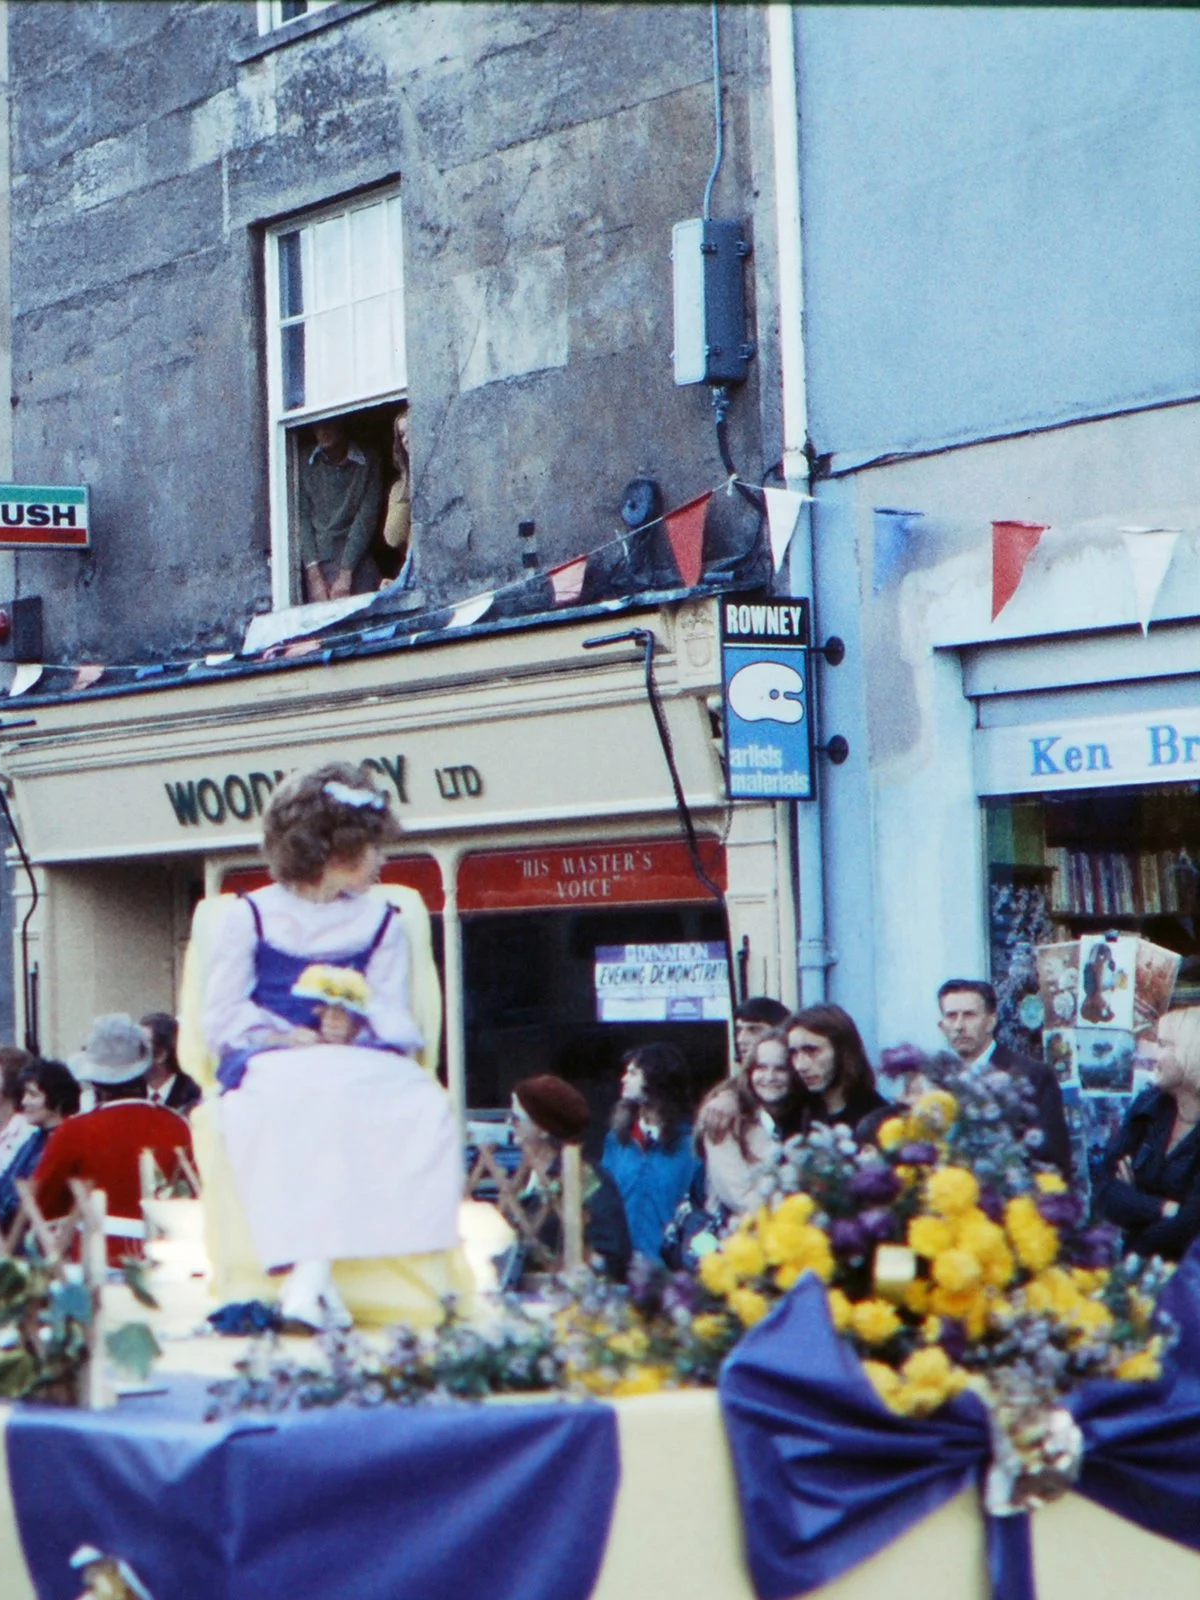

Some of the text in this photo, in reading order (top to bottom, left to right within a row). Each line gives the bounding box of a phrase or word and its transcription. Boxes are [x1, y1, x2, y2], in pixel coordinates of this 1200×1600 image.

[726, 604, 802, 636] ROWNEY
[730, 744, 783, 768] artists
[1029, 736, 1113, 776] Ken
[434, 765, 483, 800] LTD
[731, 770, 810, 794] materials
[561, 849, 653, 875] MASTER'S
